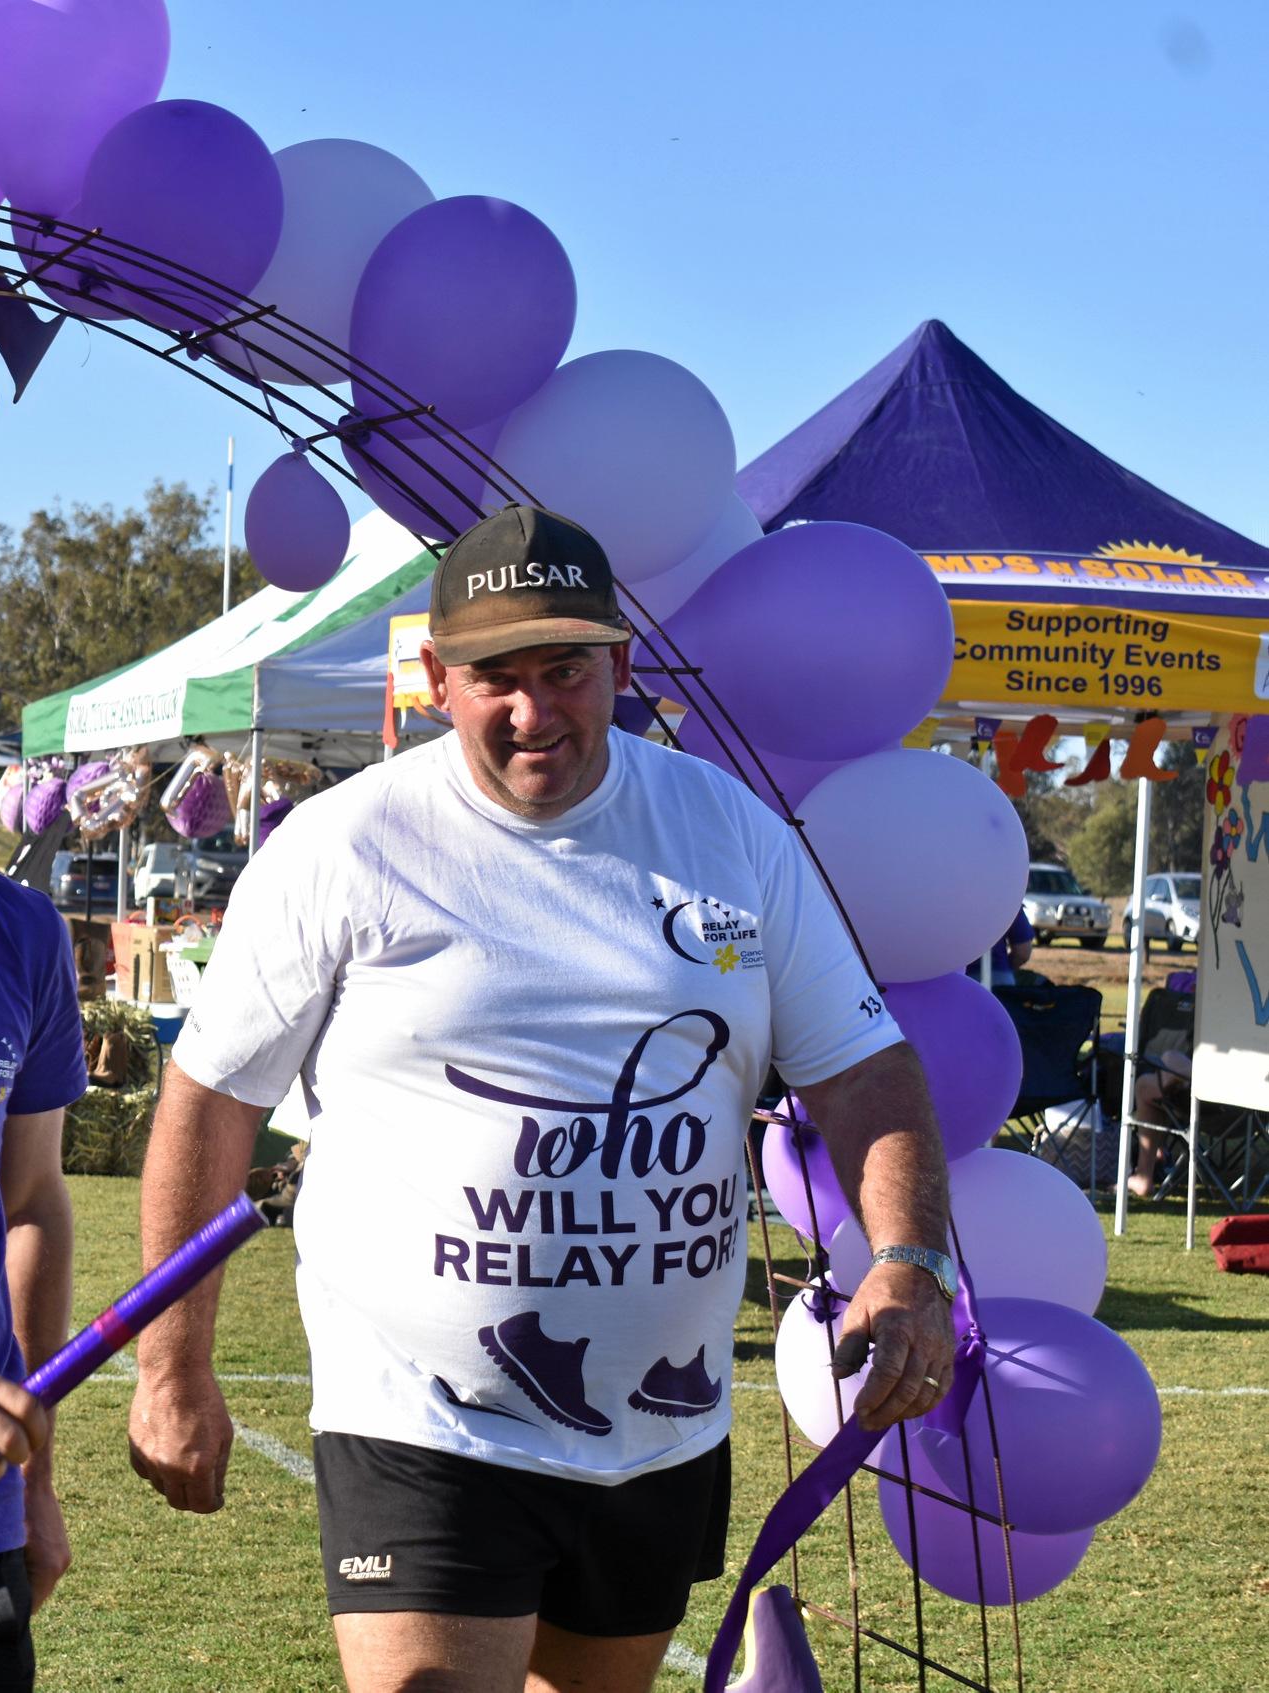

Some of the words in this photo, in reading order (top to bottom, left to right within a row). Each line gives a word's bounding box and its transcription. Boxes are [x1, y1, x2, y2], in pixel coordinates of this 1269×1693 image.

[467, 562, 589, 600] PULSAR
[1078, 560, 1256, 588] SOLAR
[1006, 609, 1169, 642] Supporting
[953, 638, 1114, 669] Community
[1125, 644, 1221, 671] Events
[1006, 670, 1088, 692] Since
[1098, 673, 1163, 697] 1996
[701, 920, 740, 931] RELAY
[703, 932, 727, 942] FOR
[730, 929, 757, 940] LIFE
[444, 1008, 730, 1180] who
[463, 1186, 636, 1234] WILL
[644, 1173, 737, 1232] YOU
[434, 1233, 641, 1288] RELAY
[339, 1554, 392, 1574] EMU
